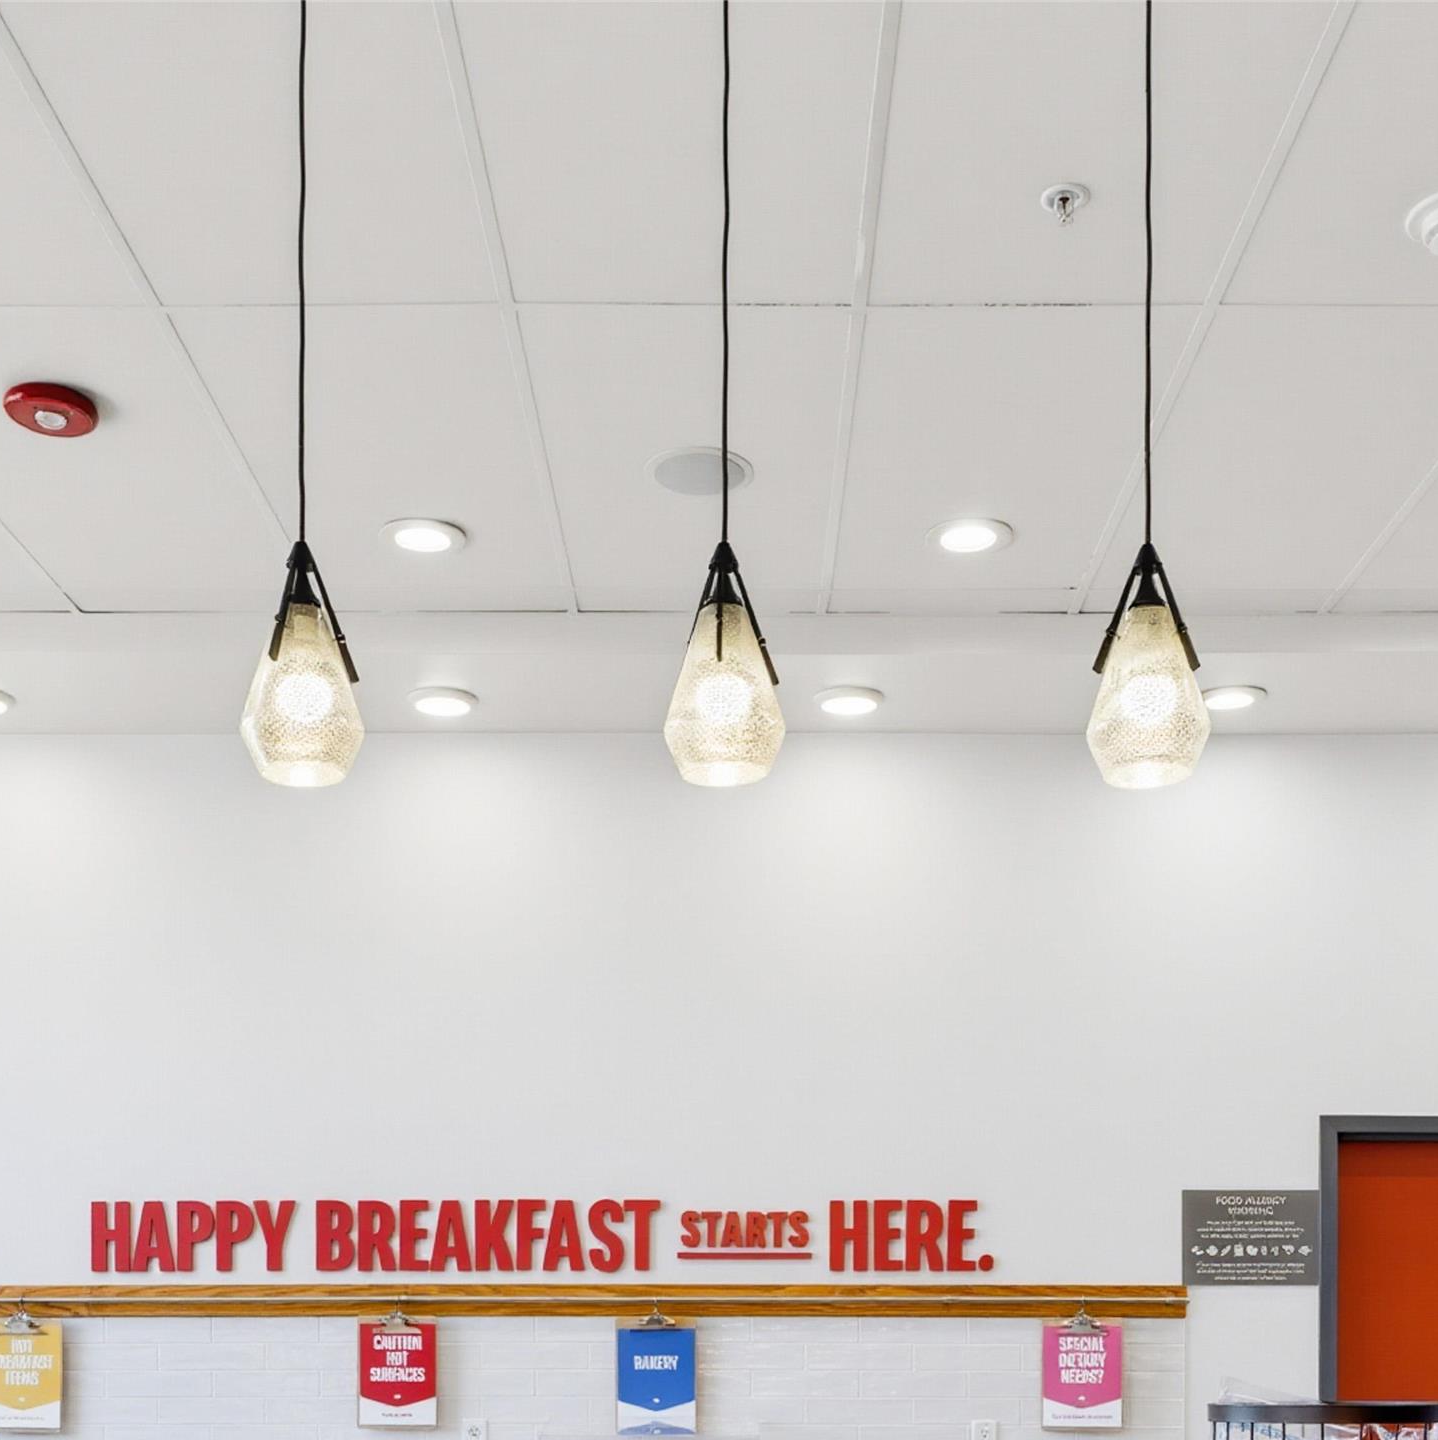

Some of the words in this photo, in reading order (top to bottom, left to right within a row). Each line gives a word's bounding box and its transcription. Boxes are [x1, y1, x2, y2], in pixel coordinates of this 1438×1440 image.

[1215, 1196, 1243, 1205] FOOD
[1244, 1196, 1287, 1206] ALLERGY
[90, 1200, 296, 1272] HAPPY
[315, 1199, 661, 1273] BREAKFAST
[680, 1210, 811, 1249] STARTS
[829, 1199, 995, 1273] HERE.
[372, 1334, 423, 1351] CAUTION
[1058, 1336, 1105, 1352] SPECIAL
[386, 1351, 409, 1367] HOT
[633, 1354, 679, 1371] BAKERY
[369, 1367, 426, 1382] SURFACES
[1060, 1368, 1105, 1385] NEEDS?
